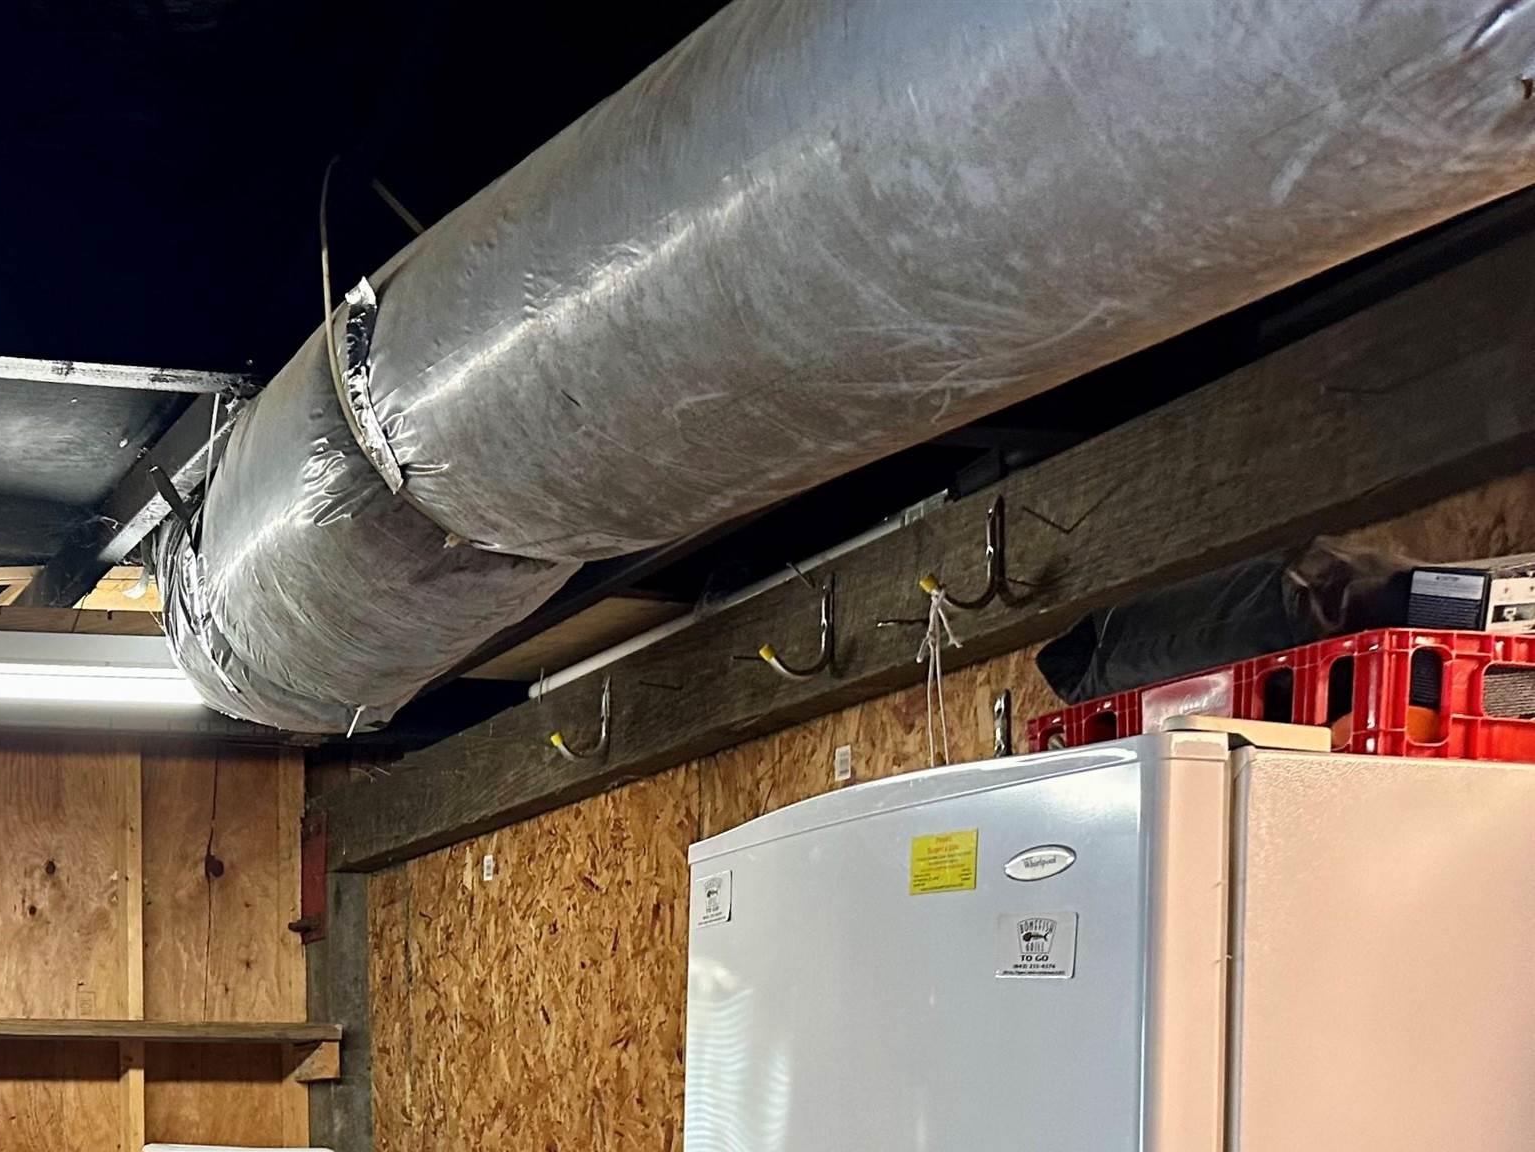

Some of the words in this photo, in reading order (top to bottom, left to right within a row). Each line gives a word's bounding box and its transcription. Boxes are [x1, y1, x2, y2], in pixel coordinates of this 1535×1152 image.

[1024, 855, 1057, 869] Whirlpool
[1020, 954, 1033, 962] TO
[1034, 954, 1049, 962] GO
